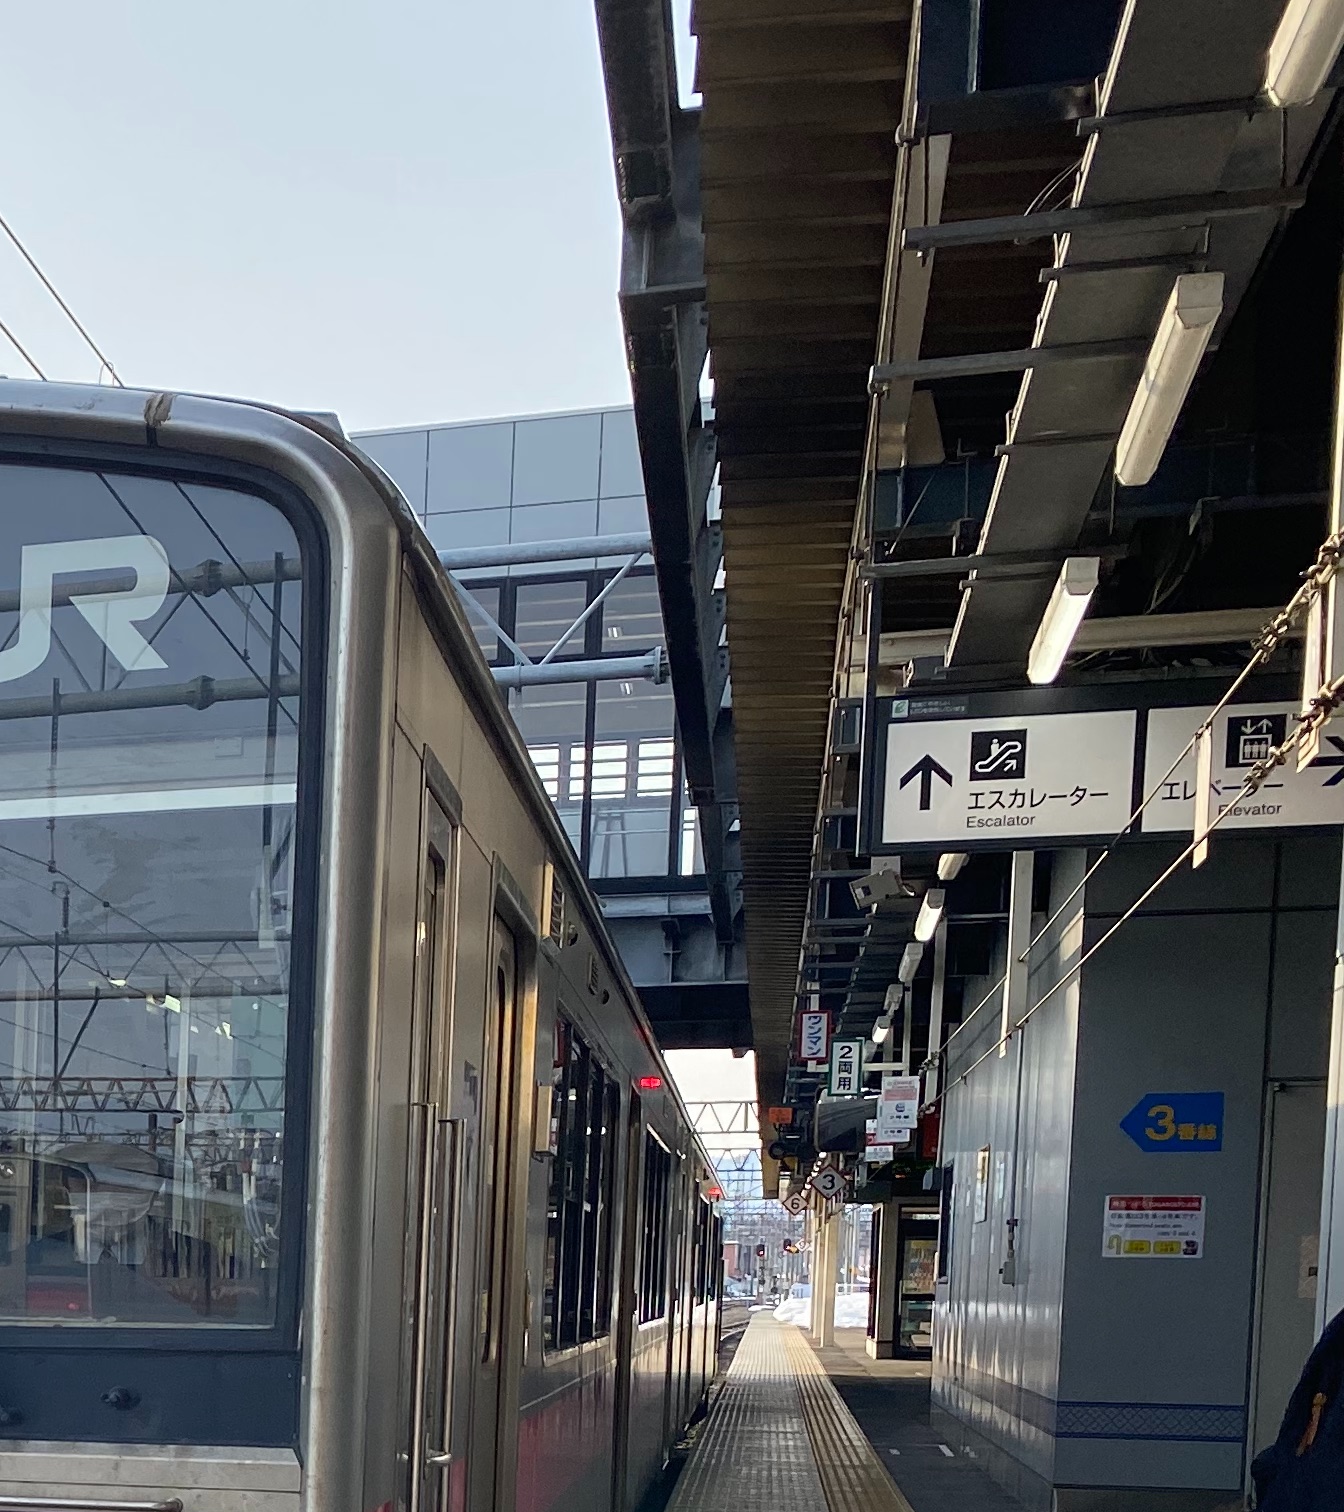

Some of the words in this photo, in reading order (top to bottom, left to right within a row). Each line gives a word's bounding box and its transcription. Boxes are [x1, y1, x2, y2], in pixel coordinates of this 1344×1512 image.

[967, 785, 1109, 810] エスカレーター
[966, 814, 1036, 829] Escalator
[806, 1014, 823, 1057] ワンマン
[836, 1044, 854, 1091] 2両用
[821, 1173, 836, 1191] 3
[790, 1197, 800, 1210] 6
